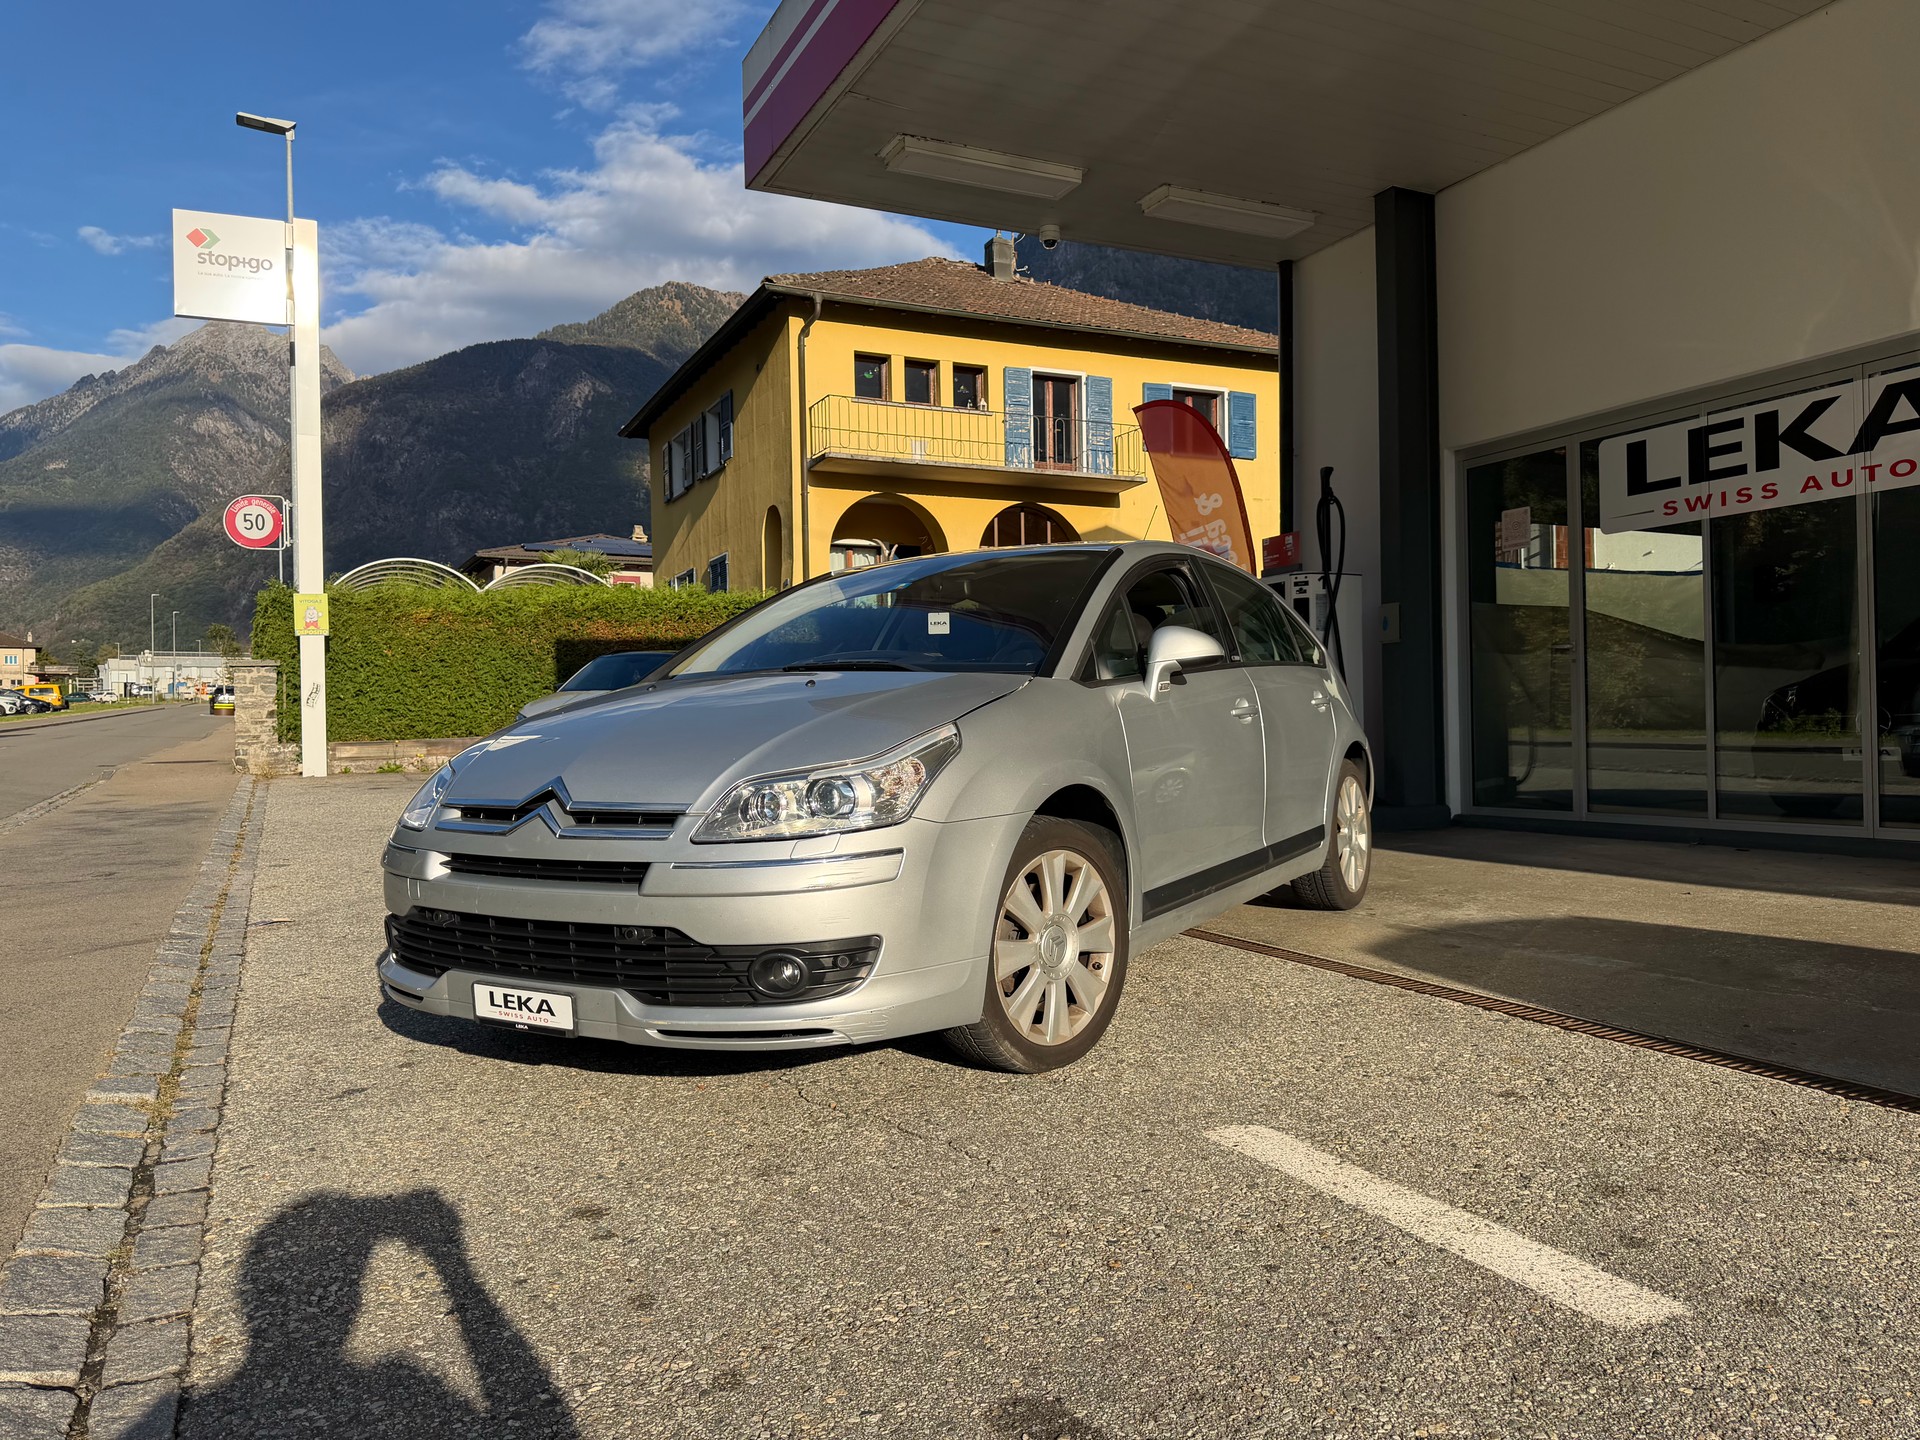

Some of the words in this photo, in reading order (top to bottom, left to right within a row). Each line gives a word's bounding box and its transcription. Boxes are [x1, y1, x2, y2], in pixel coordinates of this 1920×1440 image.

[197, 251, 273, 273] stop+go
[1626, 378, 1920, 497] LEKA
[1662, 482, 1779, 517] SWISS
[1800, 458, 1918, 494] AUTO
[244, 514, 265, 531] 50
[489, 990, 557, 1017] LEKA
[498, 1010, 524, 1019] SWISS
[527, 1015, 549, 1024] AUTO
